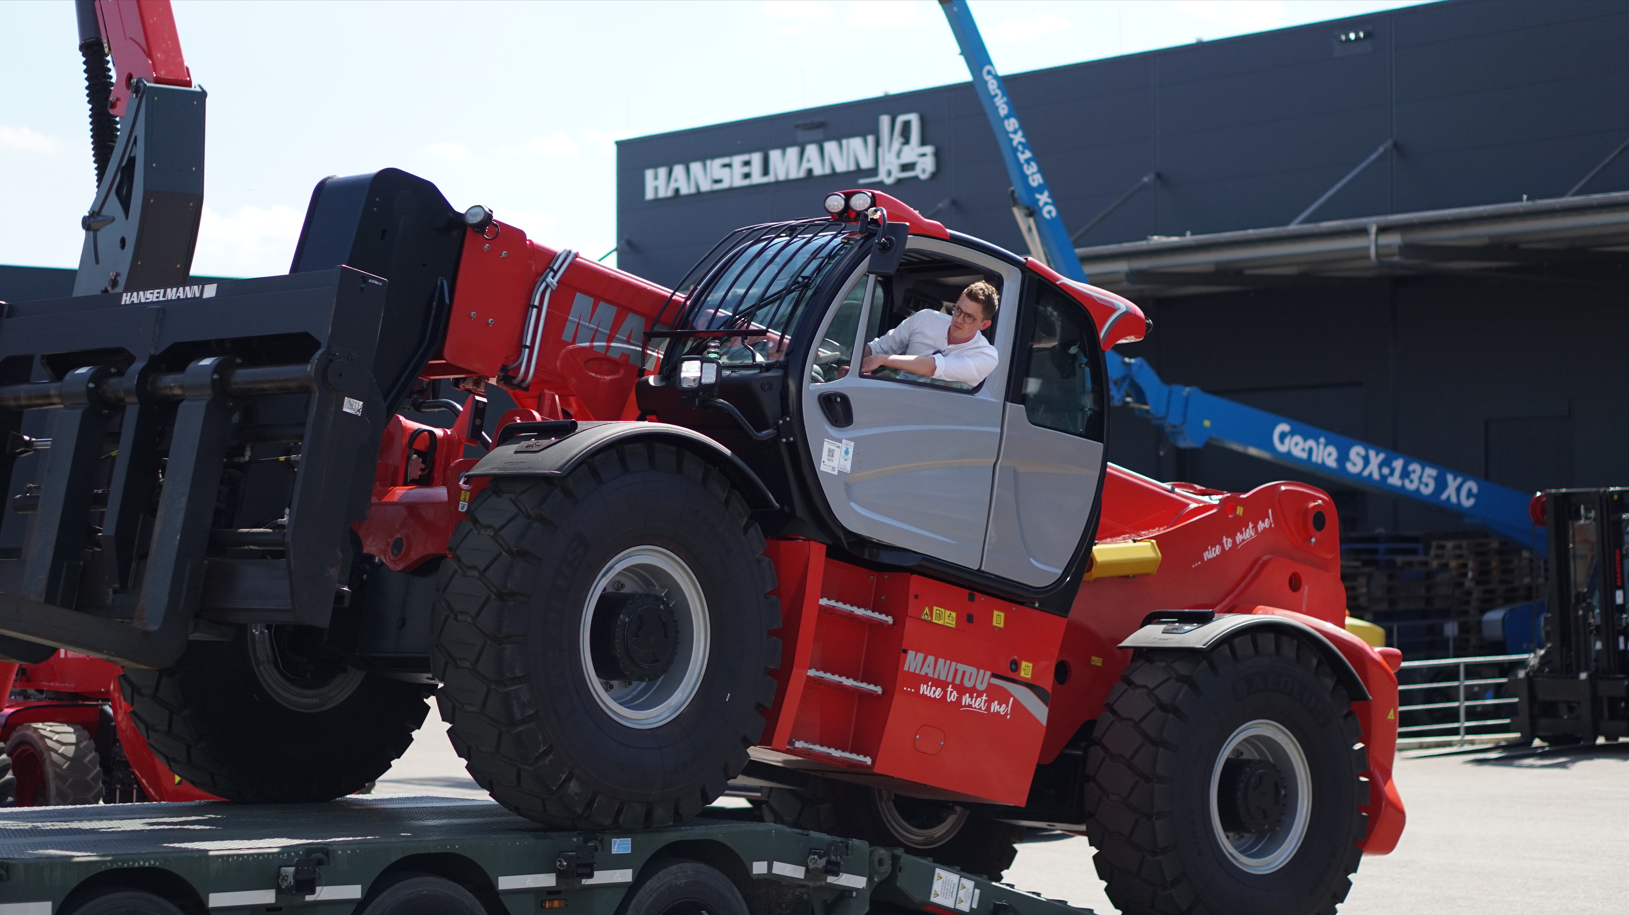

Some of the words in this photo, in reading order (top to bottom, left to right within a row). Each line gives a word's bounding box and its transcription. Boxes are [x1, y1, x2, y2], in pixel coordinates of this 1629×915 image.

[644, 134, 877, 200] HANSELMANN
[982, 65, 1009, 118] Genie
[1004, 117, 1044, 187] SX-135
[1035, 190, 1057, 220] XC
[121, 285, 202, 305] HANSELMANN
[1273, 422, 1338, 469] Genie
[1345, 445, 1438, 496] SX-135
[1440, 473, 1478, 508] XC
[1203, 545, 1222, 562] nice
[1222, 535, 1233, 551] to
[1235, 521, 1257, 546] miet
[1256, 508, 1275, 533] me!
[903, 650, 992, 691] MANITOU
[919, 682, 944, 699] nice
[946, 684, 959, 702] to
[960, 692, 988, 712] miet
[990, 697, 1014, 720] me!
